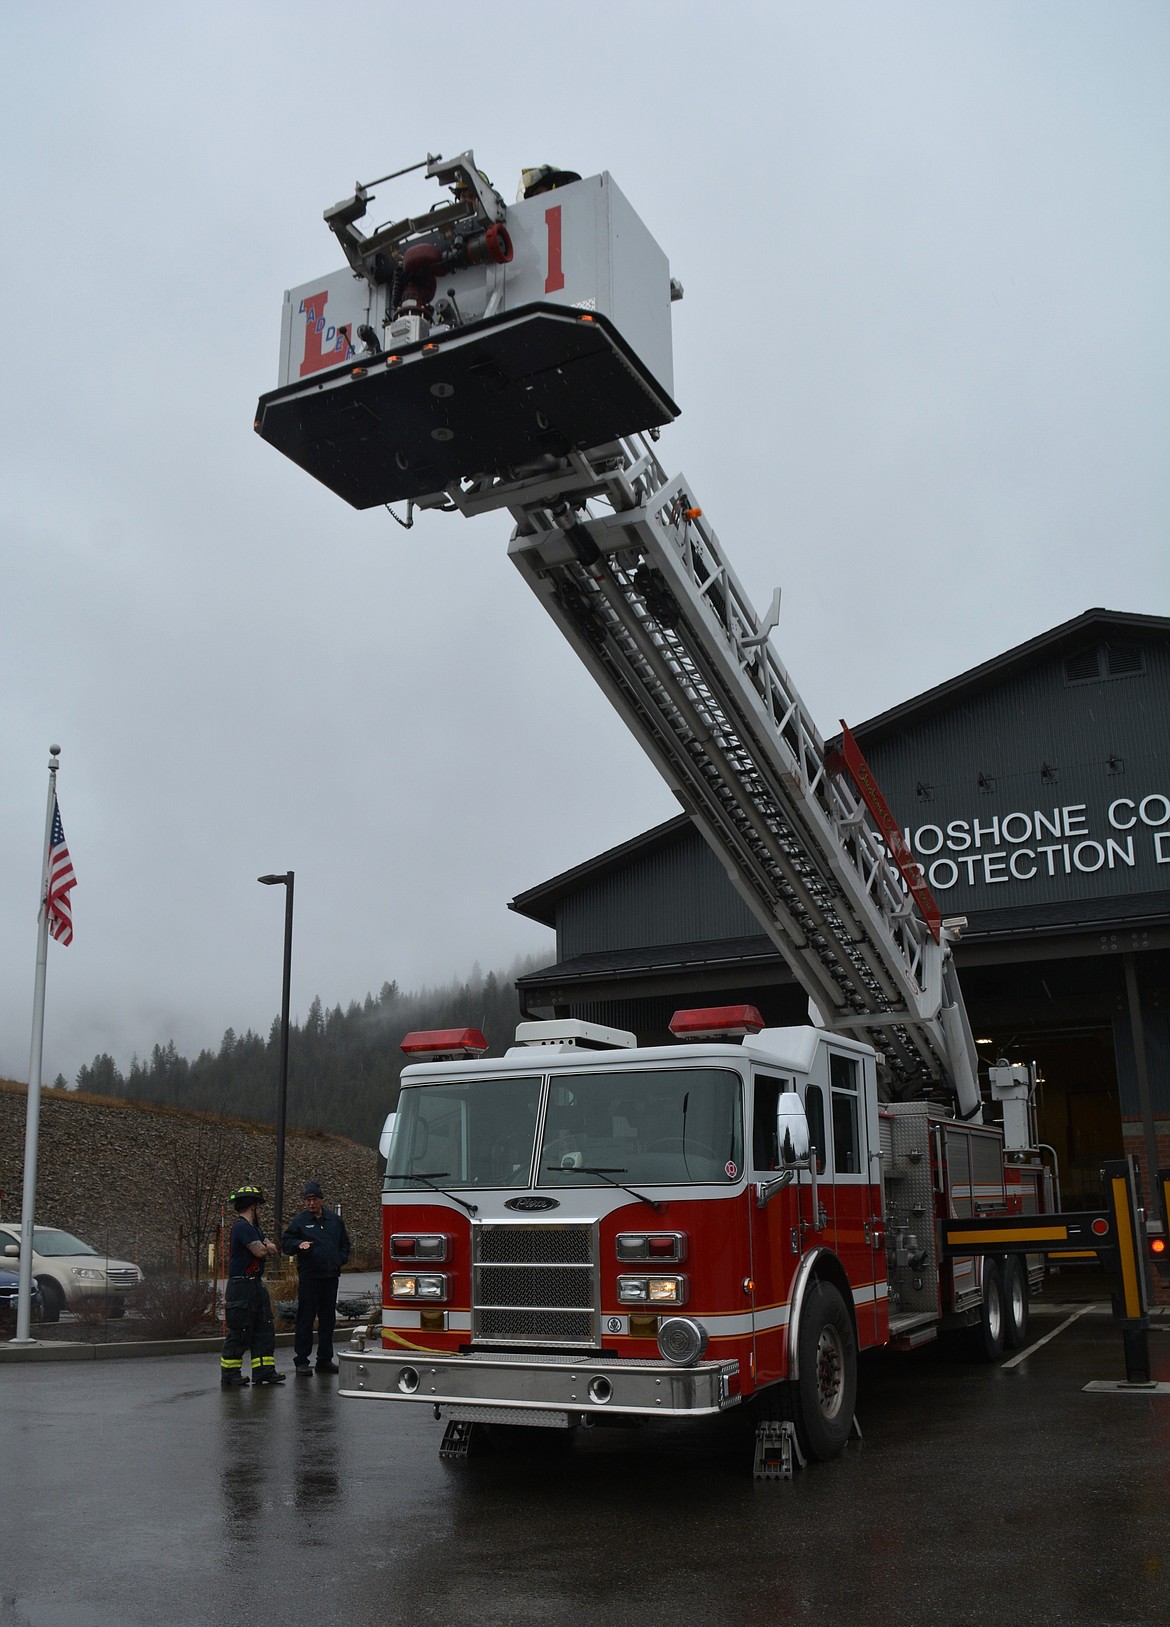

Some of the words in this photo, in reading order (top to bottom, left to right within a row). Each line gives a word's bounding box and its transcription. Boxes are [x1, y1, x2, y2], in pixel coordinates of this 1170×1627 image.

[545, 205, 565, 294] 1
[299, 300, 355, 361] LADDER
[1108, 794, 1170, 830] CO
